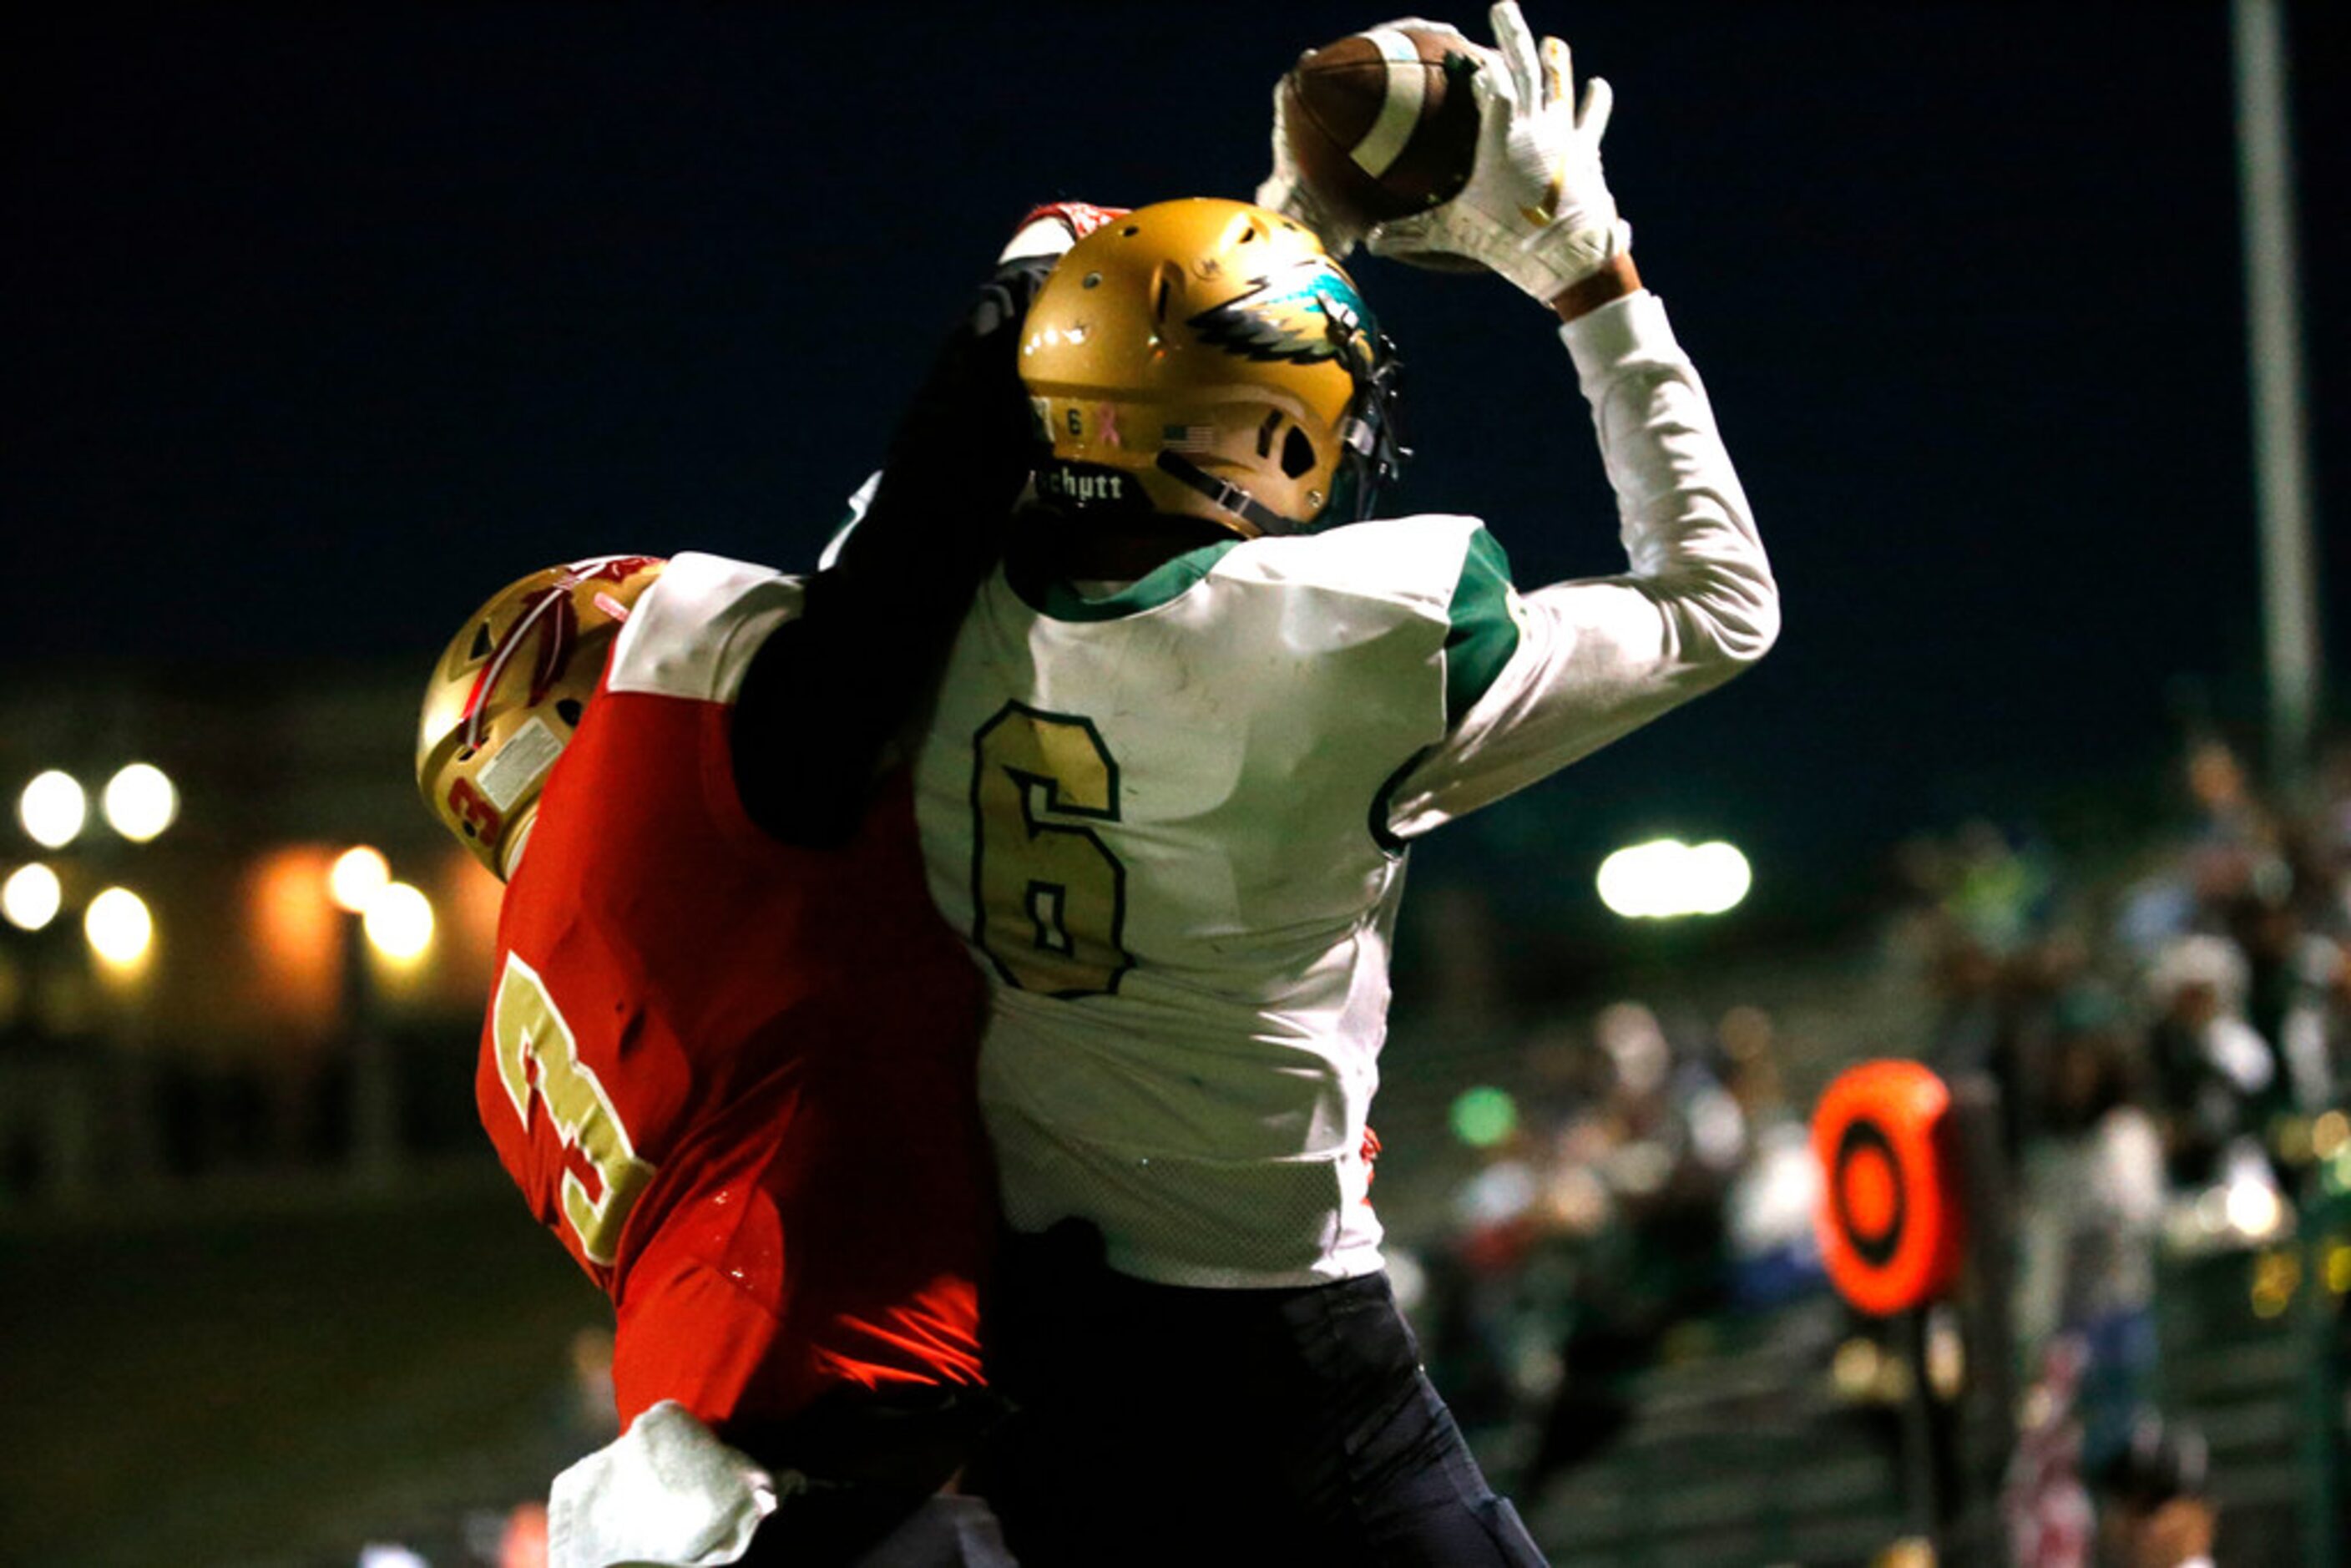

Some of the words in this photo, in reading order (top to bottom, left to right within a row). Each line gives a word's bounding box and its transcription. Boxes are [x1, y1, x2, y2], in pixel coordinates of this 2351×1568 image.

[1068, 409, 1082, 434] 6
[447, 776, 500, 848] 3
[969, 697, 1136, 1000] 6
[493, 949, 658, 1267] 3
